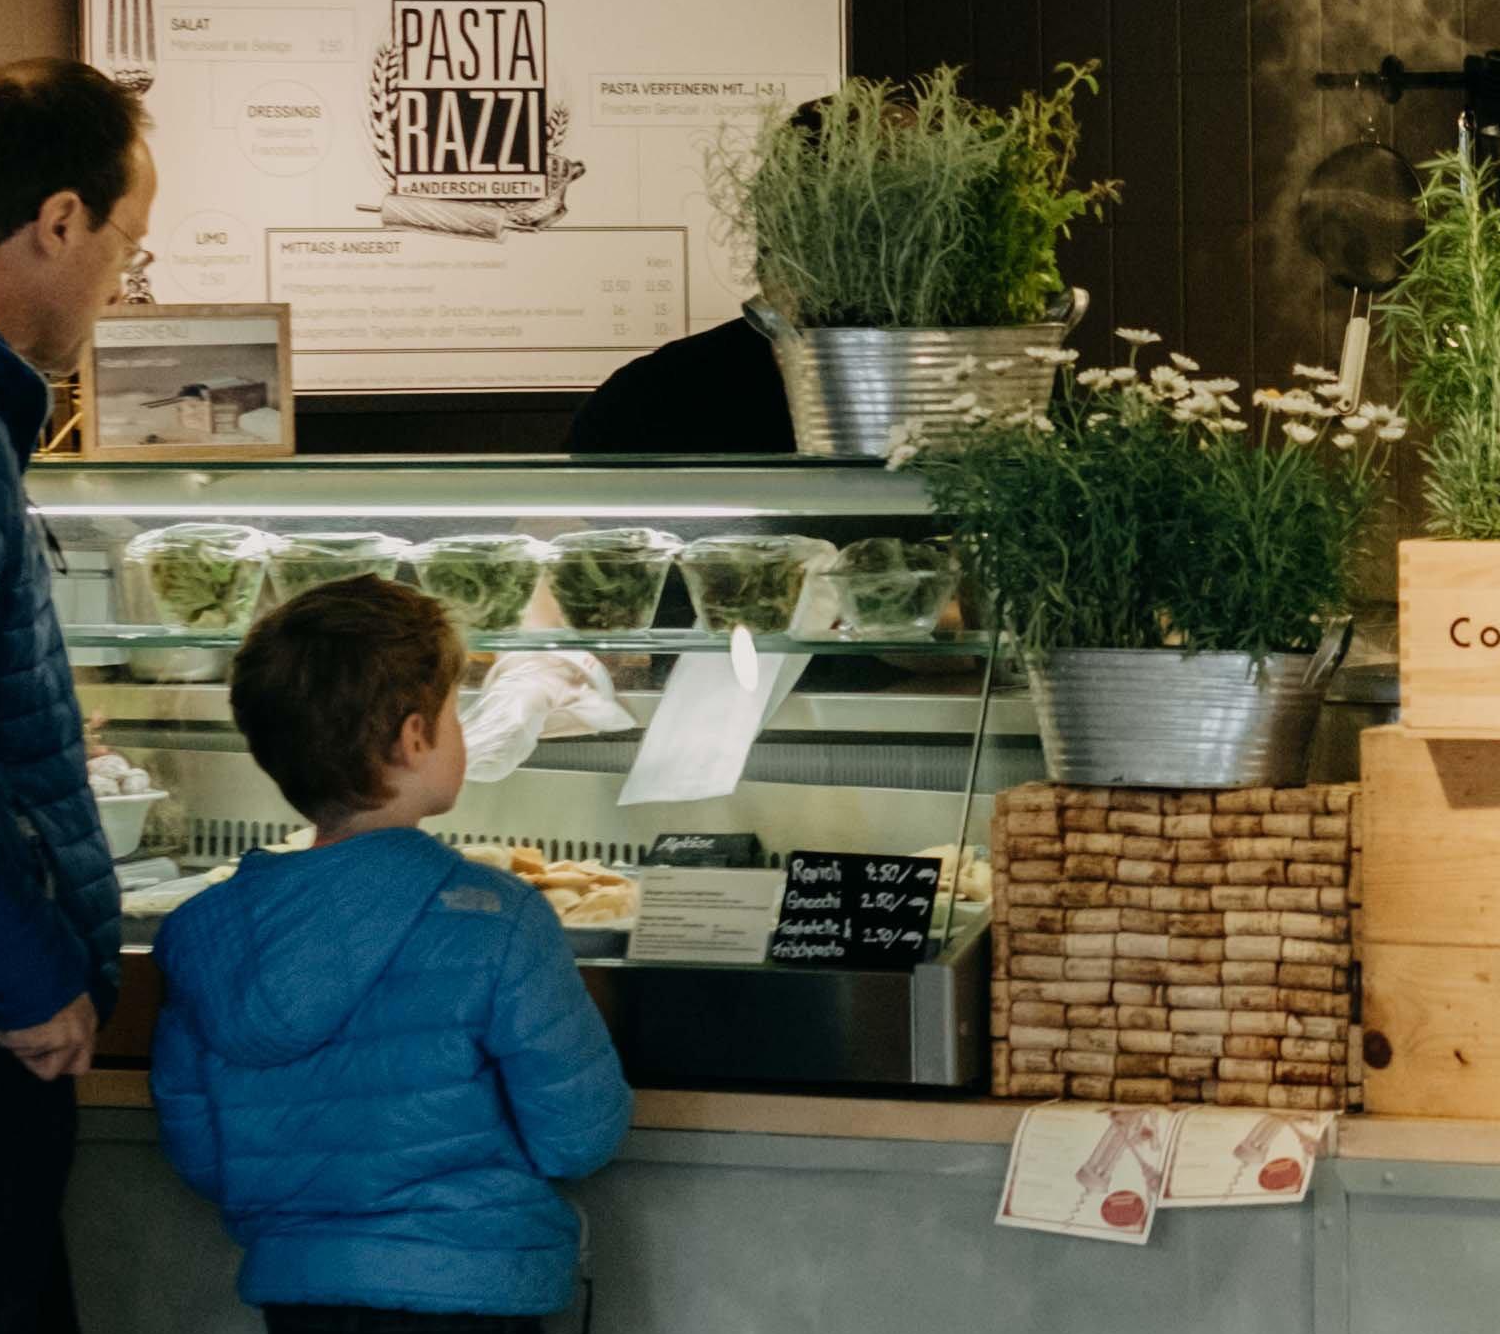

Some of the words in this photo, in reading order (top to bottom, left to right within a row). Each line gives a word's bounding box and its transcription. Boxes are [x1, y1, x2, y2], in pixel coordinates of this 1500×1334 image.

[170, 17, 211, 31] SALAT
[401, 8, 538, 81] PASTA
[600, 82, 639, 95] PASTA
[641, 82, 719, 95] VERFEINERN
[247, 105, 322, 119] DRESSINGS
[399, 90, 541, 172] RAZZI
[281, 241, 403, 255] MITTAGS-ANGEBOT
